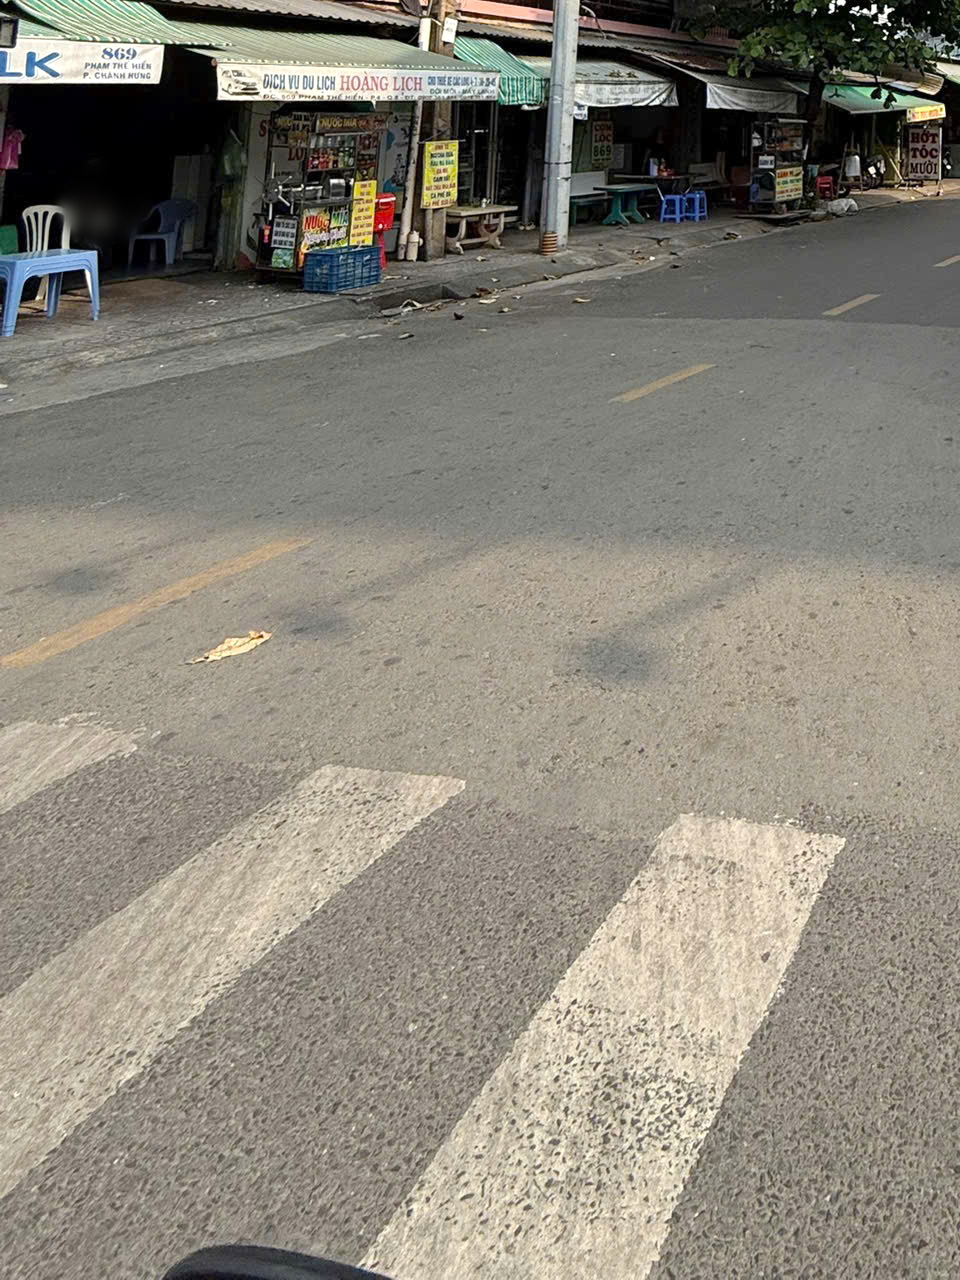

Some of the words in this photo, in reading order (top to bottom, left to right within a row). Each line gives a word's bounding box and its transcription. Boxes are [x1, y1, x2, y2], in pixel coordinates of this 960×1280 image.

[101, 47, 138, 60] 869
[302, 75, 315, 90] DU
[340, 71, 390, 92] HOÀNG
[393, 76, 422, 96] LỊCH
[910, 130, 938, 144] HỚT
[593, 145, 612, 158] 869
[910, 145, 938, 159] TÓC
[909, 160, 938, 175] MƯỜI
